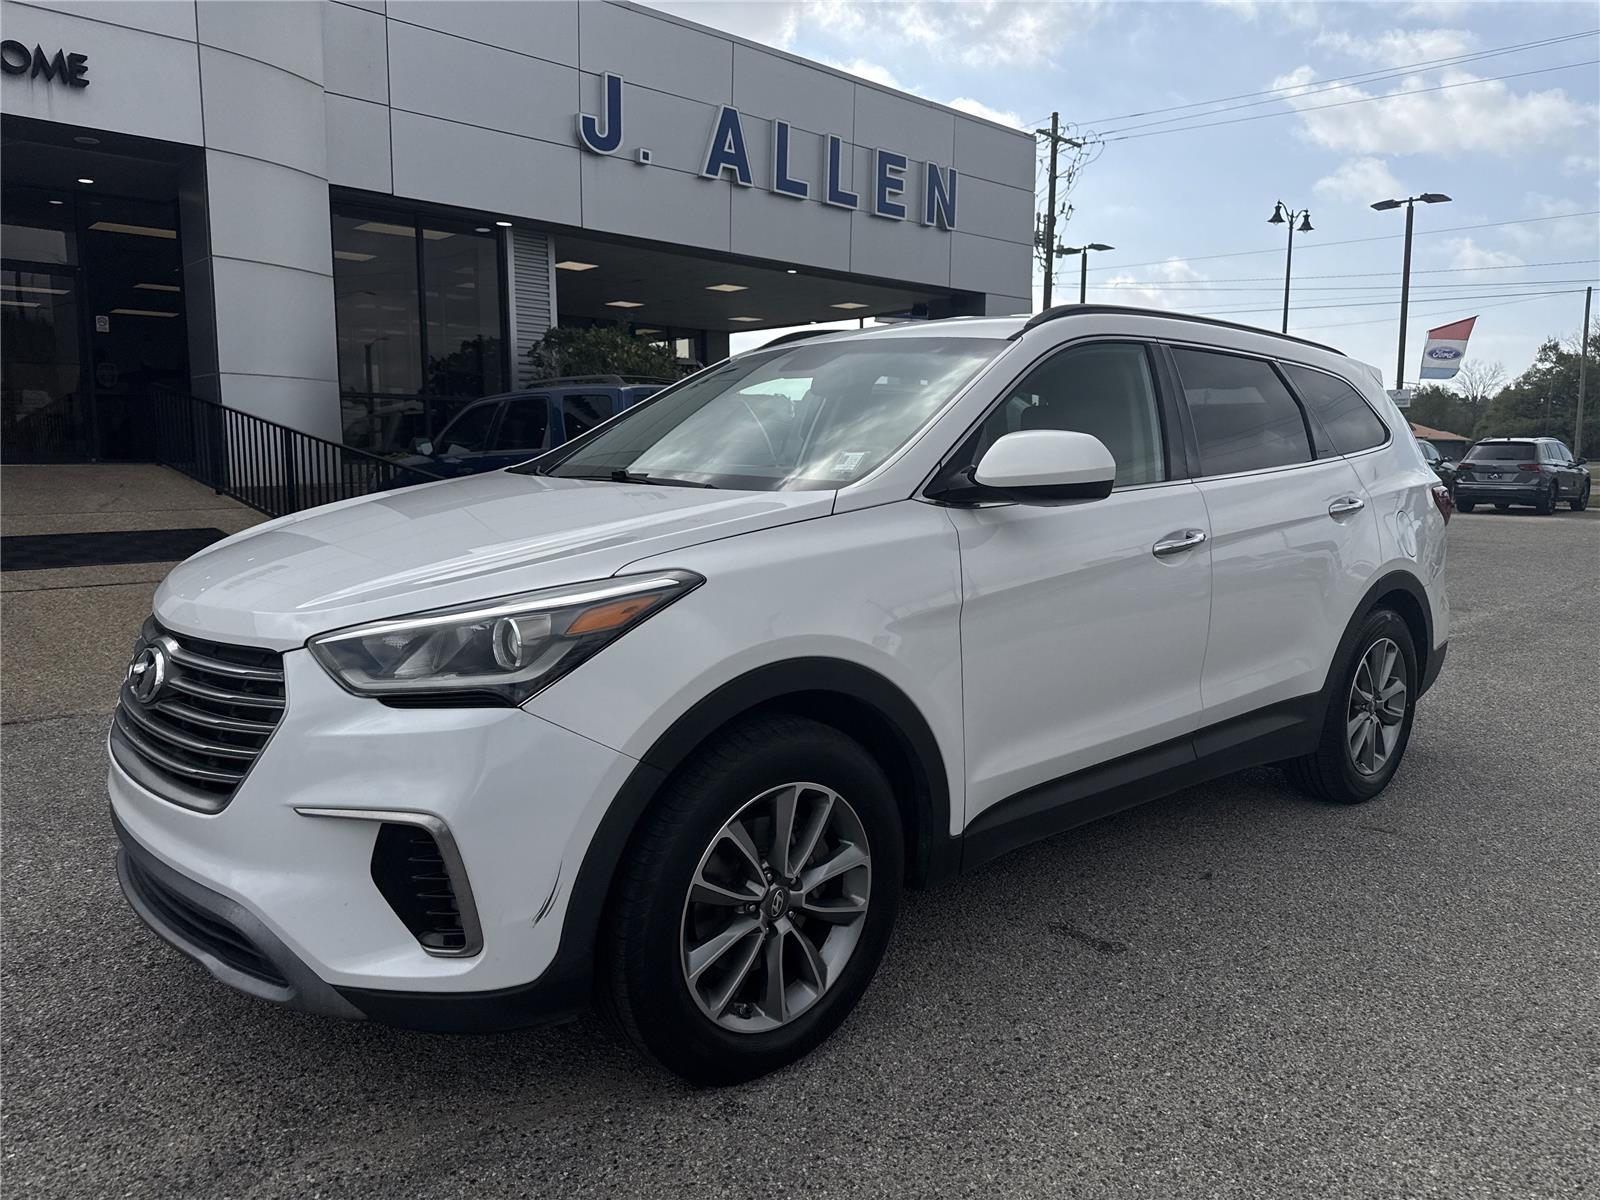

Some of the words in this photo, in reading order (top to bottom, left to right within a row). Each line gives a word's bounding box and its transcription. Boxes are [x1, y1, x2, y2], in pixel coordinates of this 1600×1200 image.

[0, 40, 90, 88] OME
[577, 71, 651, 164] J.
[700, 104, 958, 230] ALLEN
[1432, 349, 1456, 359] Ford
